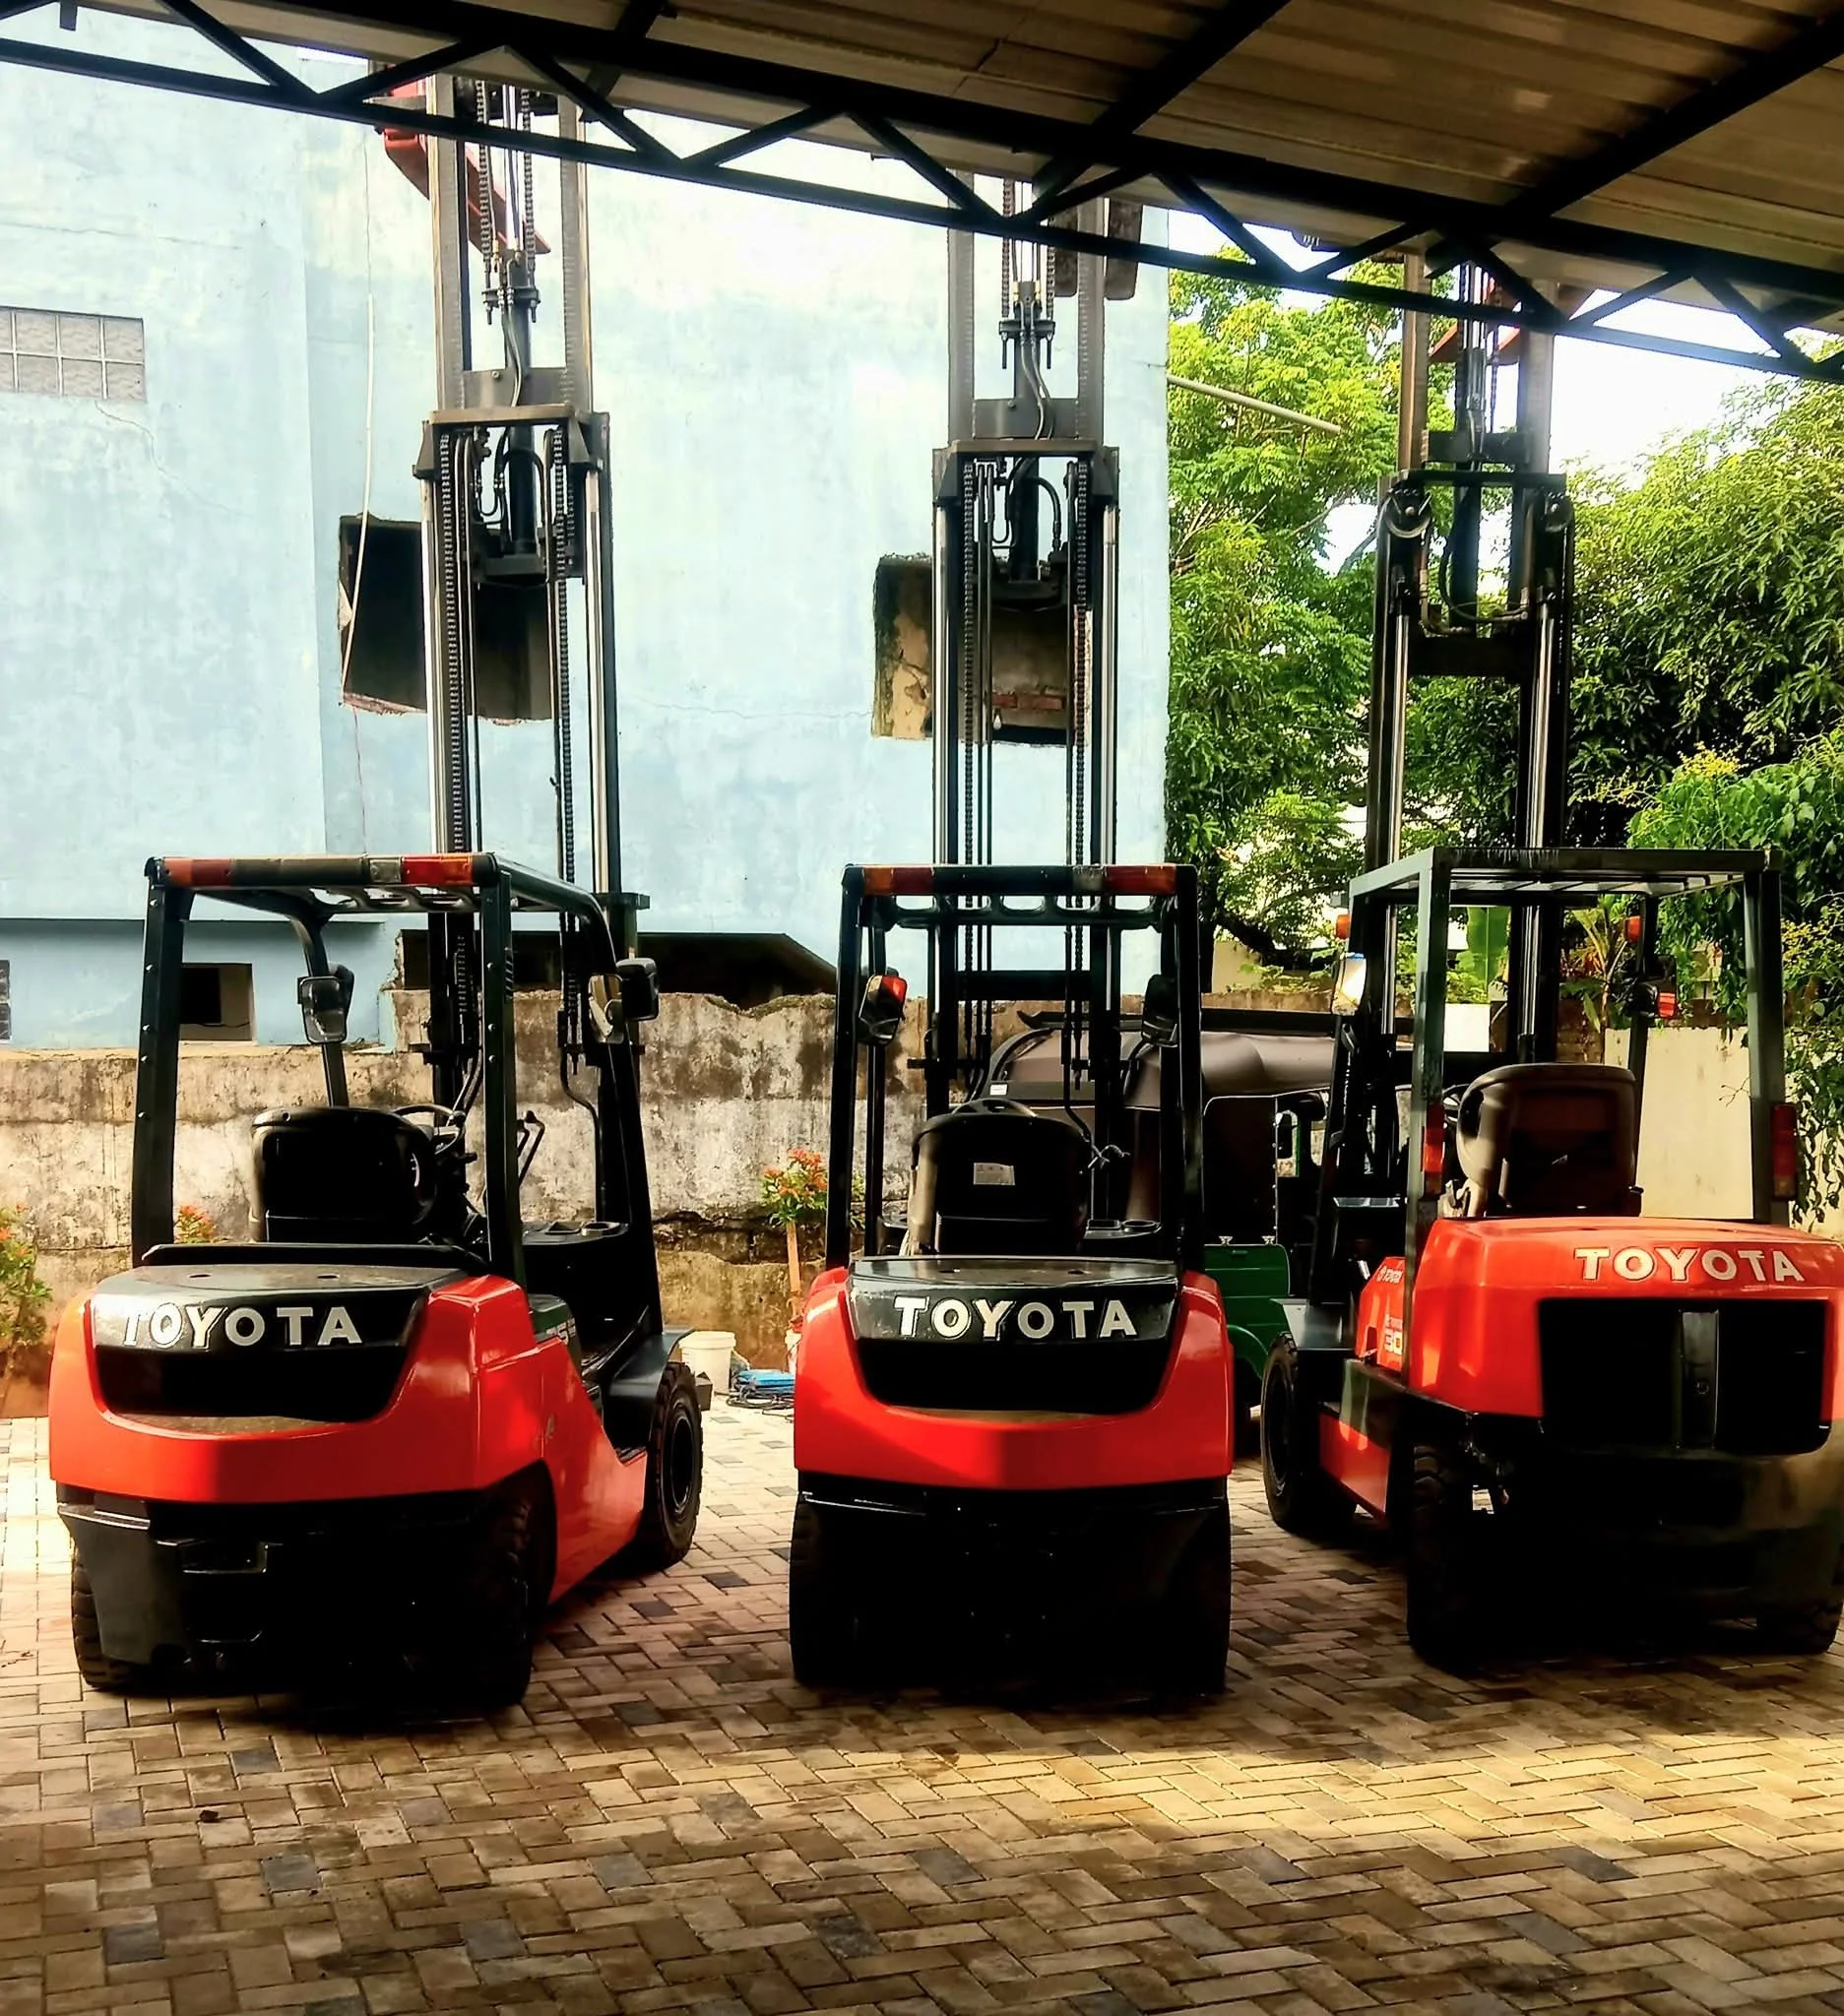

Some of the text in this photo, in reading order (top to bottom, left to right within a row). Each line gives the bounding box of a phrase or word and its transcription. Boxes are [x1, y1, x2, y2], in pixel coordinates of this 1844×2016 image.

[1574, 1246, 1806, 1282] TOYOTA
[121, 1303, 363, 1349] TOYOTA
[894, 1296, 1138, 1341] TOYOTA
